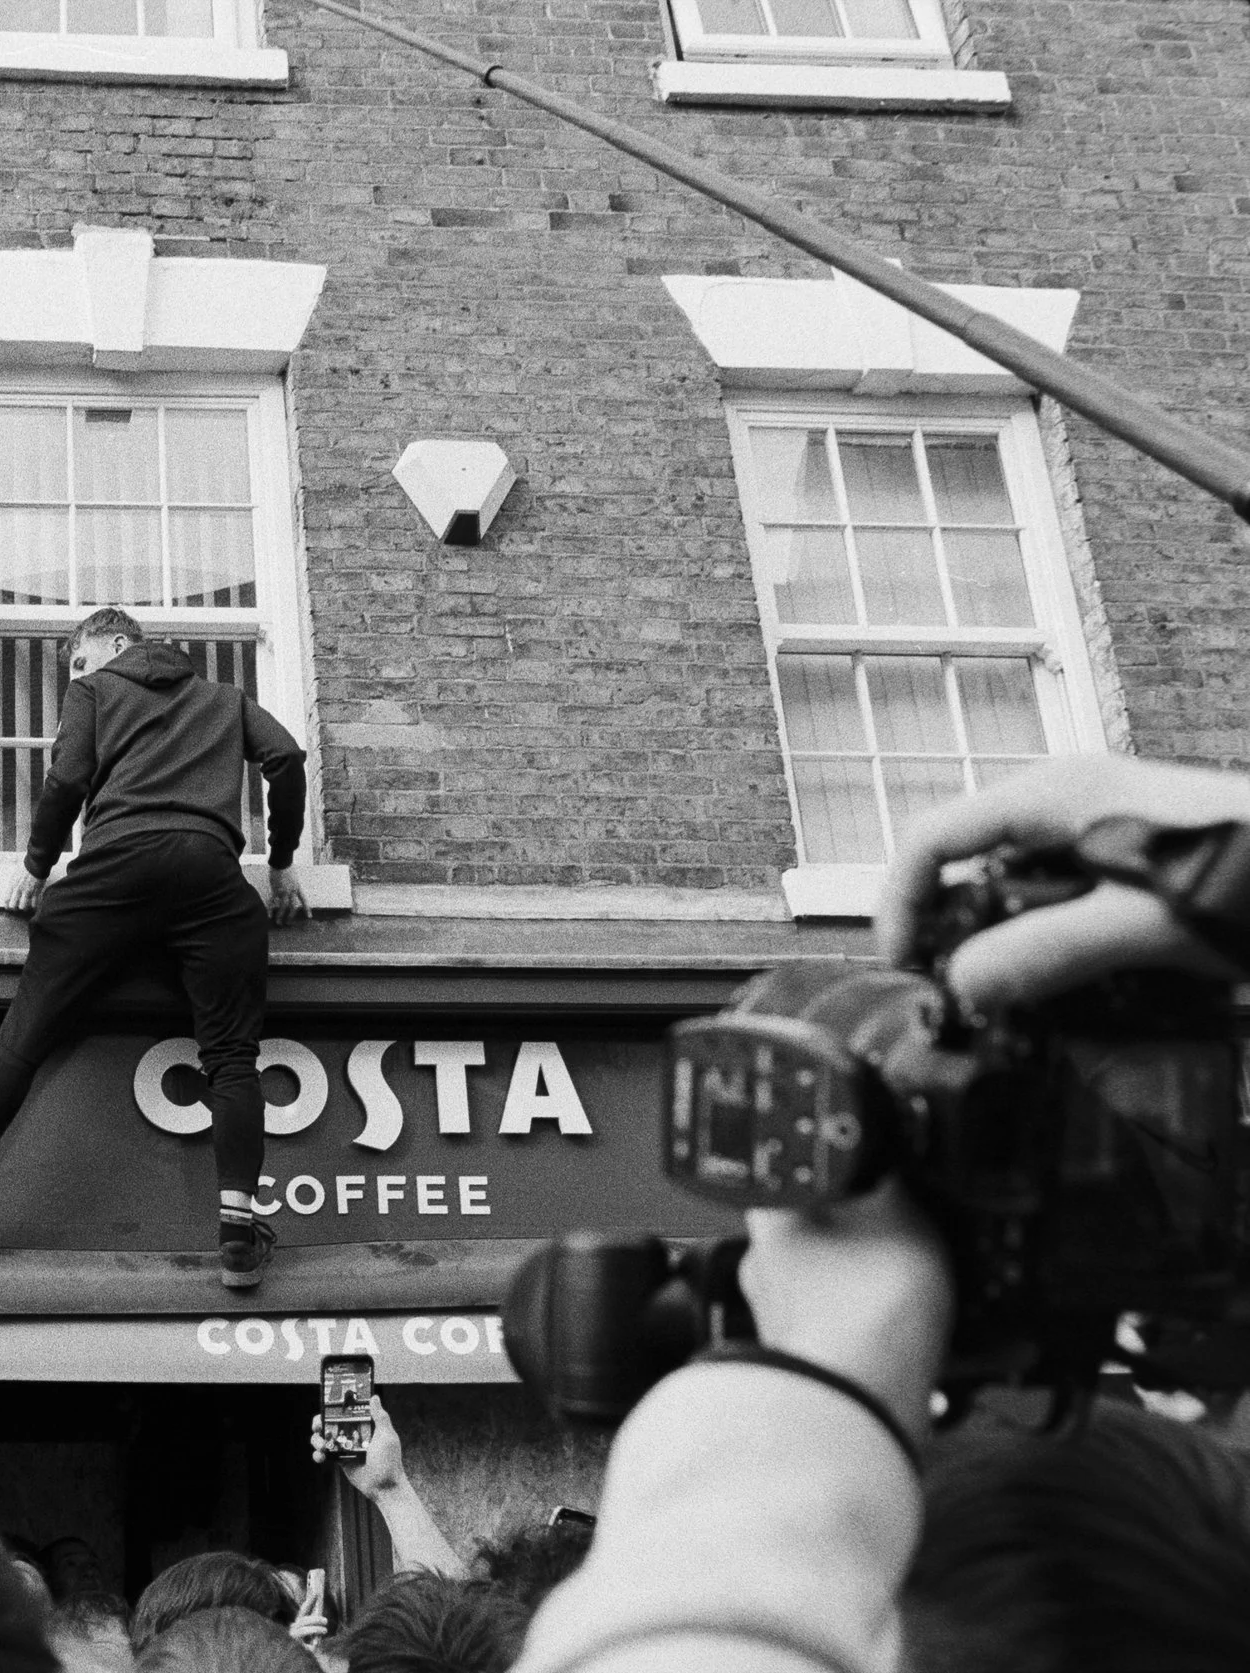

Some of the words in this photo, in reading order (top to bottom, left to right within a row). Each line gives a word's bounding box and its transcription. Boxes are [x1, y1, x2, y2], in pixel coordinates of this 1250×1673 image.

[133, 1037, 593, 1150] COSTA
[250, 1174, 492, 1215] COFFEE
[197, 1318, 380, 1361] COSTA
